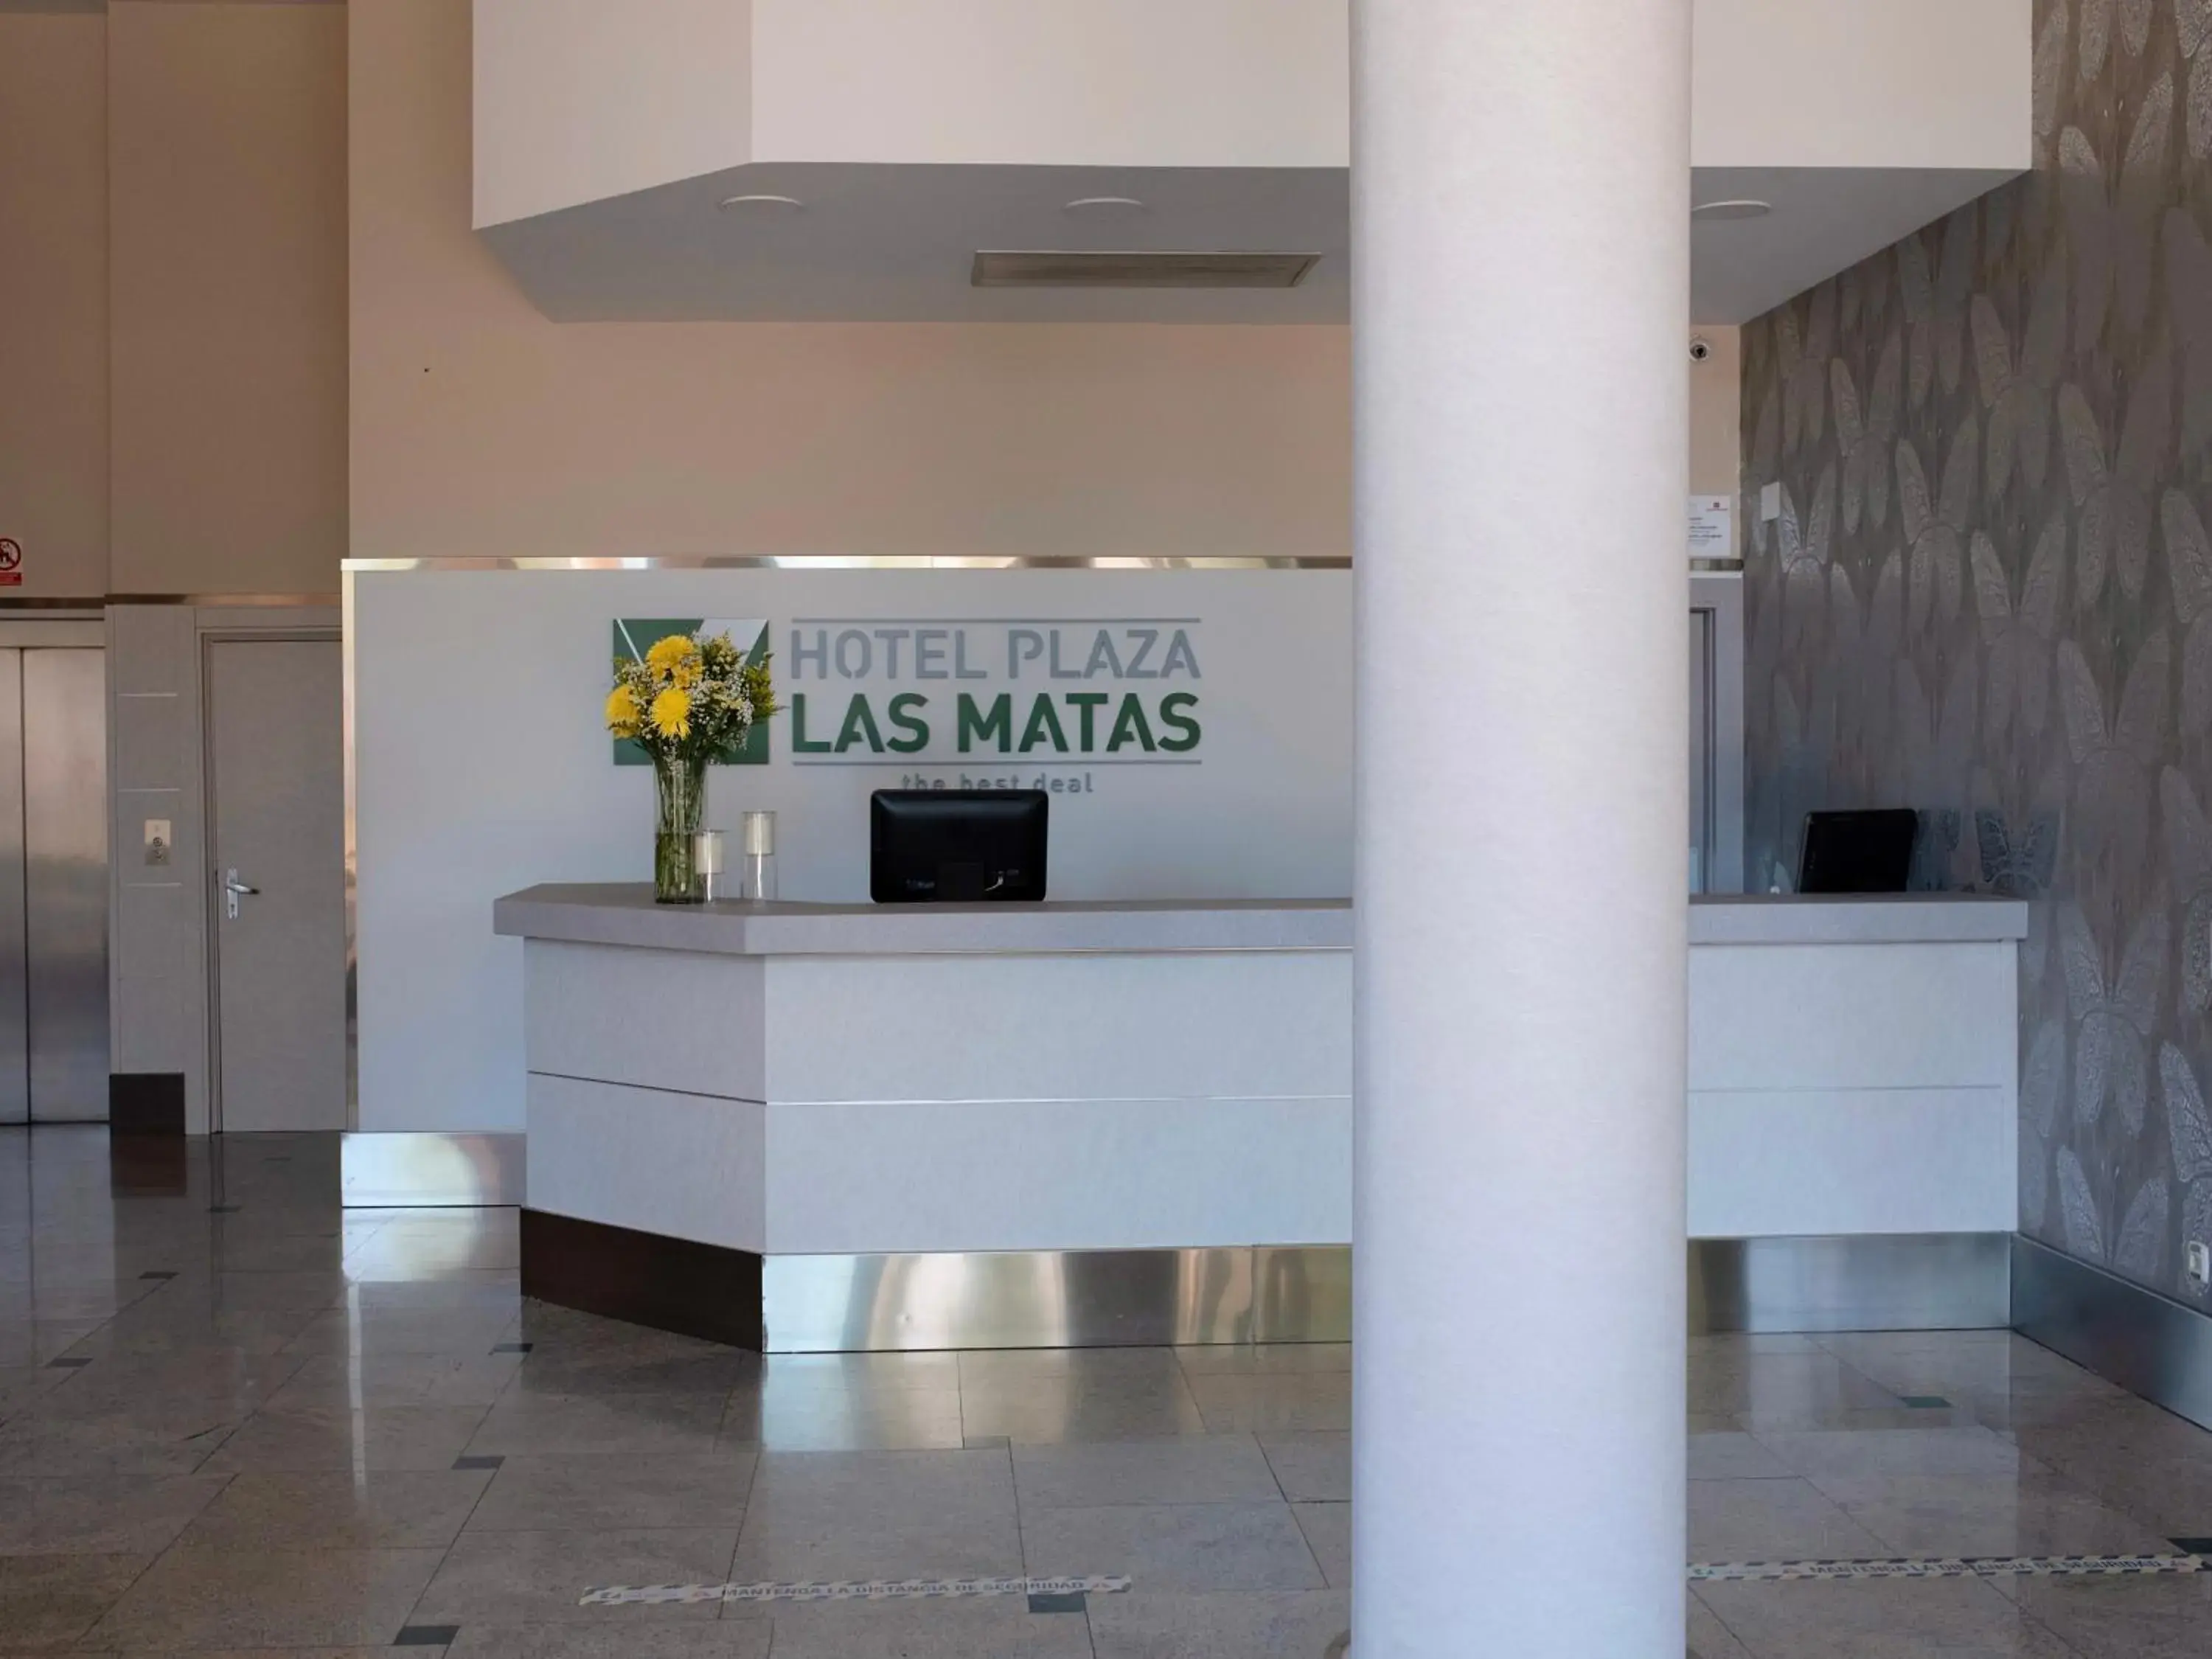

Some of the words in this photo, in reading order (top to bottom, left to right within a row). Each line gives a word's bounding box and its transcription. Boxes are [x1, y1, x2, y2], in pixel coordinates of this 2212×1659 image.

[790, 629, 988, 680] HOTEL
[1008, 629, 1201, 679] PLAZA
[792, 692, 931, 754] LAS
[957, 692, 1201, 753] MATAS
[901, 773, 947, 790] the
[1033, 772, 1094, 793] deal
